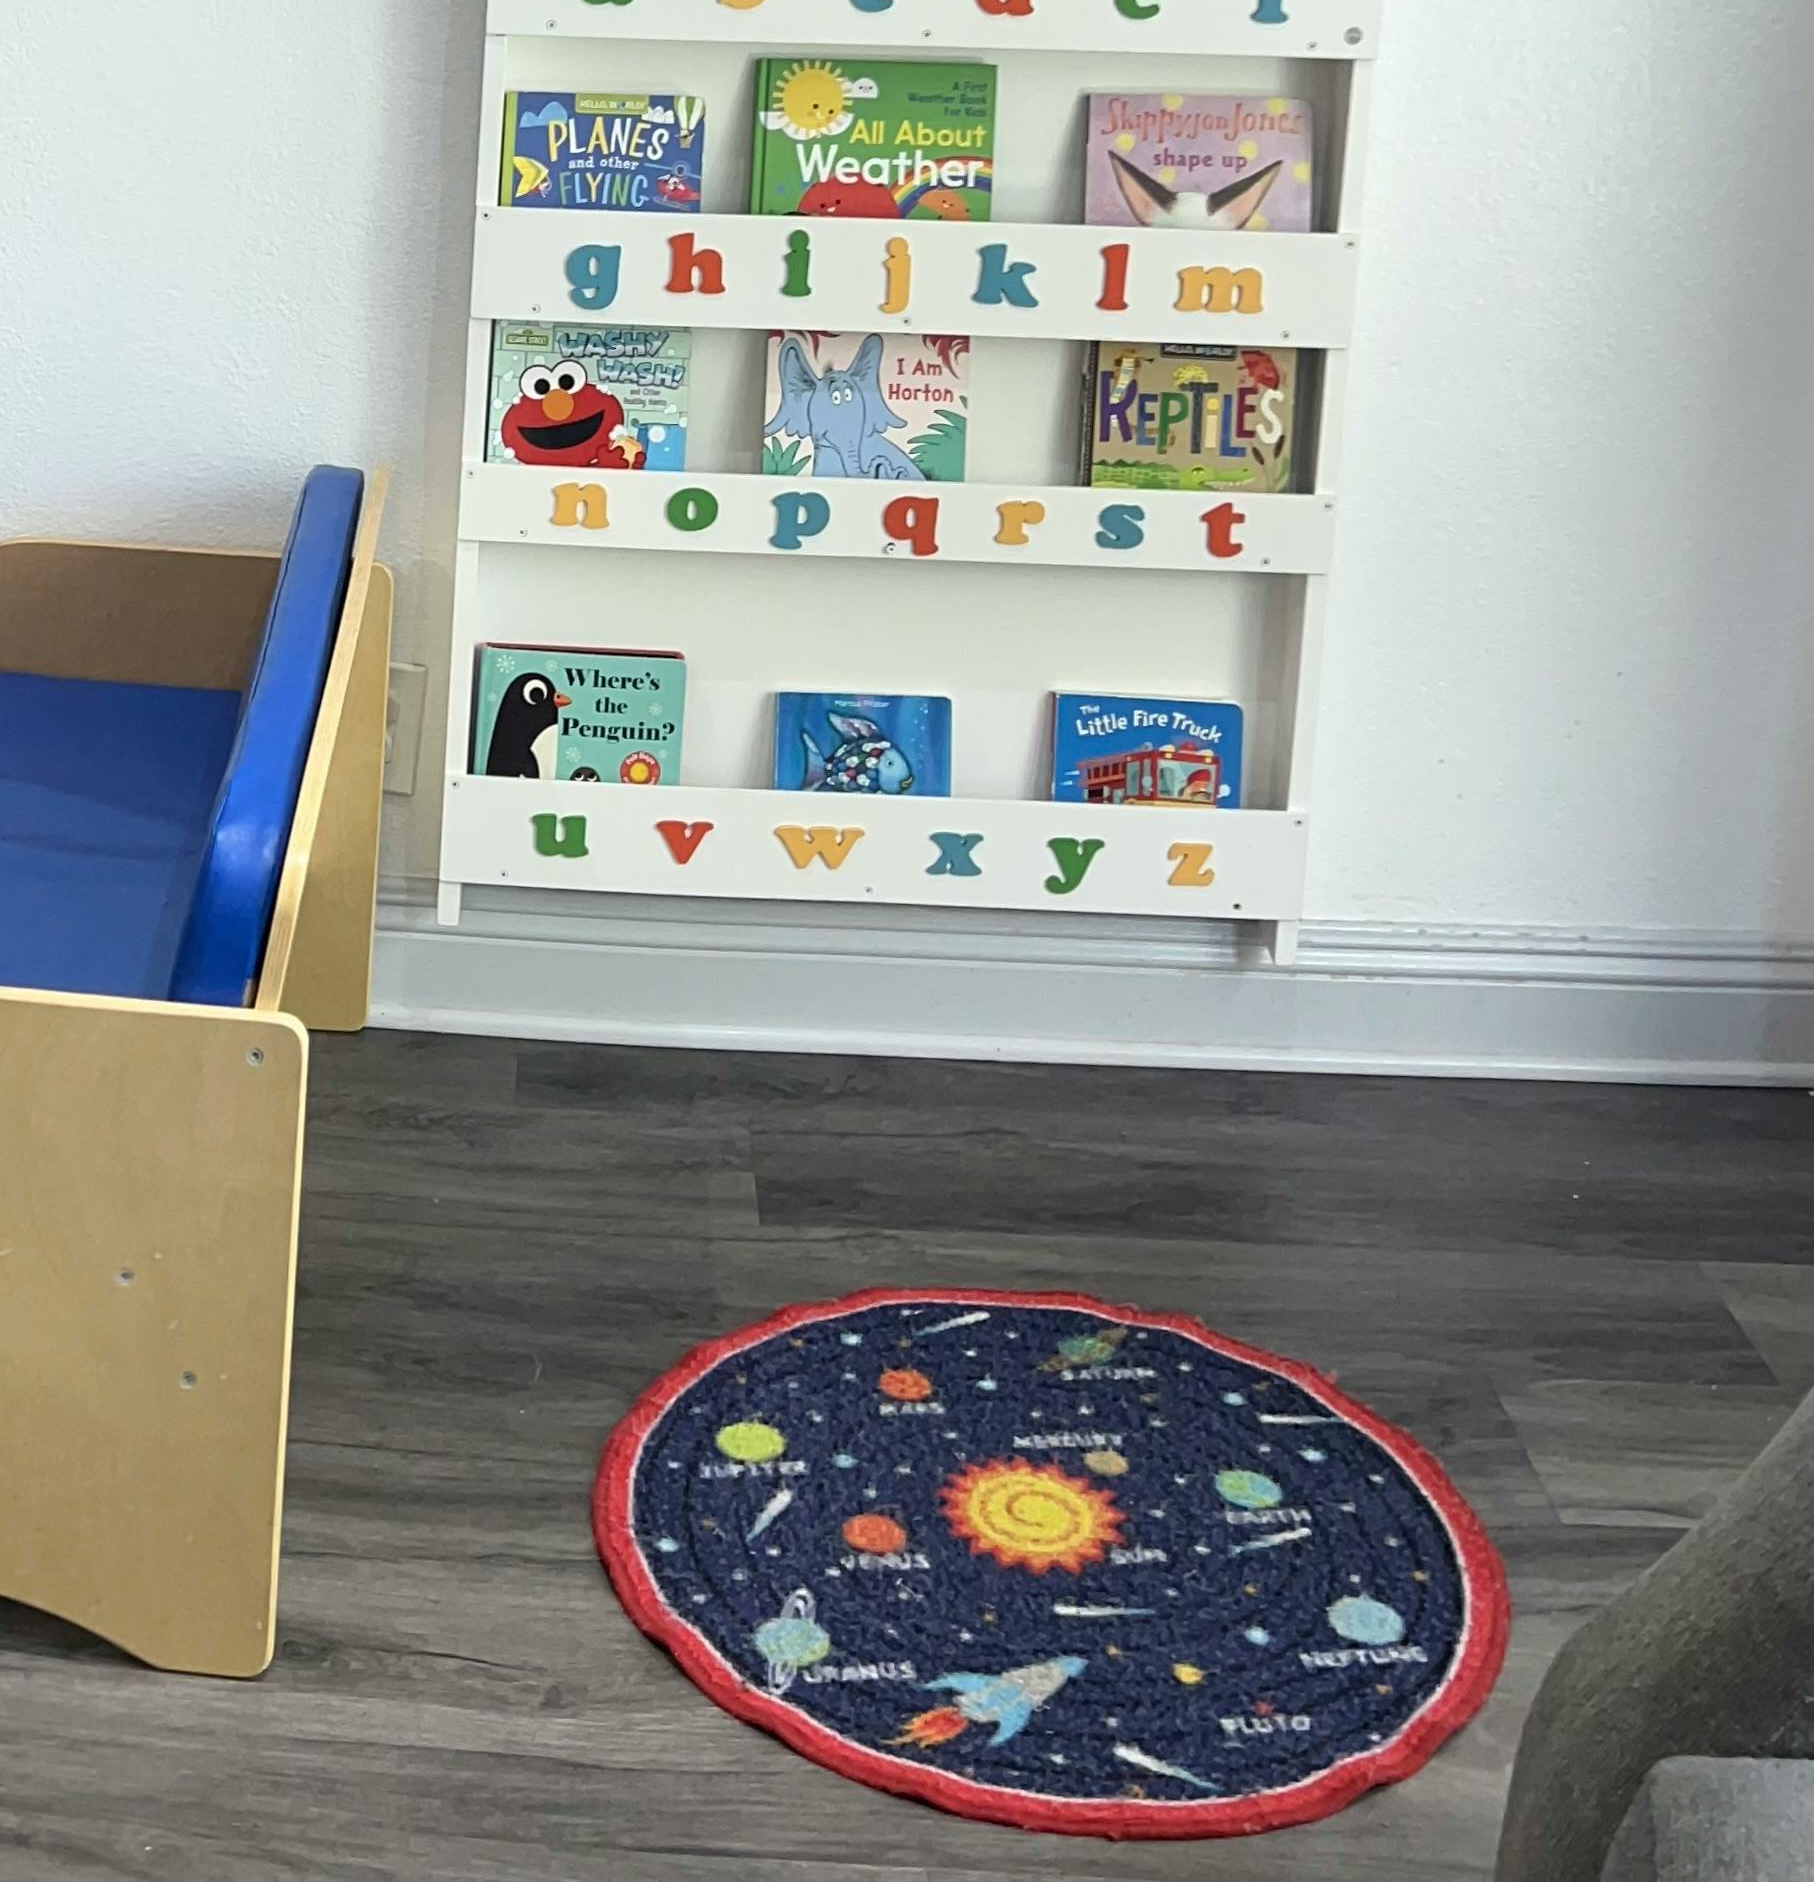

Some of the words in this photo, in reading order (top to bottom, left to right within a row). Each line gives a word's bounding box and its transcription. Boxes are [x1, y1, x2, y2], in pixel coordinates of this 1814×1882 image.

[547, 116, 669, 162] PLANES
[849, 119, 886, 144] All
[894, 120, 986, 147] About
[569, 157, 595, 168] and
[599, 156, 639, 170] other
[796, 143, 984, 187] Weather
[1153, 147, 1213, 172] shape
[1222, 155, 1248, 173] up
[559, 172, 649, 207] FLYING
[564, 244, 621, 310] g
[666, 233, 726, 295] h
[781, 229, 813, 298] i
[879, 236, 912, 314] j
[970, 244, 1040, 308] k
[1096, 244, 1129, 310] l
[1173, 265, 1264, 313] m
[557, 330, 669, 359] WASHY
[596, 359, 686, 389] WASH!
[897, 358, 905, 375] I
[912, 359, 943, 376] Am
[888, 383, 954, 403] Horton
[550, 482, 610, 529] n
[665, 487, 718, 531] o
[769, 491, 831, 549] p
[882, 495, 939, 556] q
[994, 500, 1045, 546] r
[1096, 504, 1146, 549] s
[1199, 501, 1245, 558] t
[595, 697, 628, 714] the
[561, 718, 675, 744] Penguin?
[1076, 713, 1128, 736] Little
[1132, 710, 1168, 727] Fire
[1172, 712, 1223, 743] Truck
[532, 813, 590, 858] u
[656, 820, 714, 864] v
[775, 825, 865, 870] w
[928, 832, 985, 876] x
[1045, 837, 1105, 894] y
[1168, 843, 1215, 887] z
[801, 1663, 917, 1682] URANUS
[1220, 1716, 1312, 1737] PLUTO
